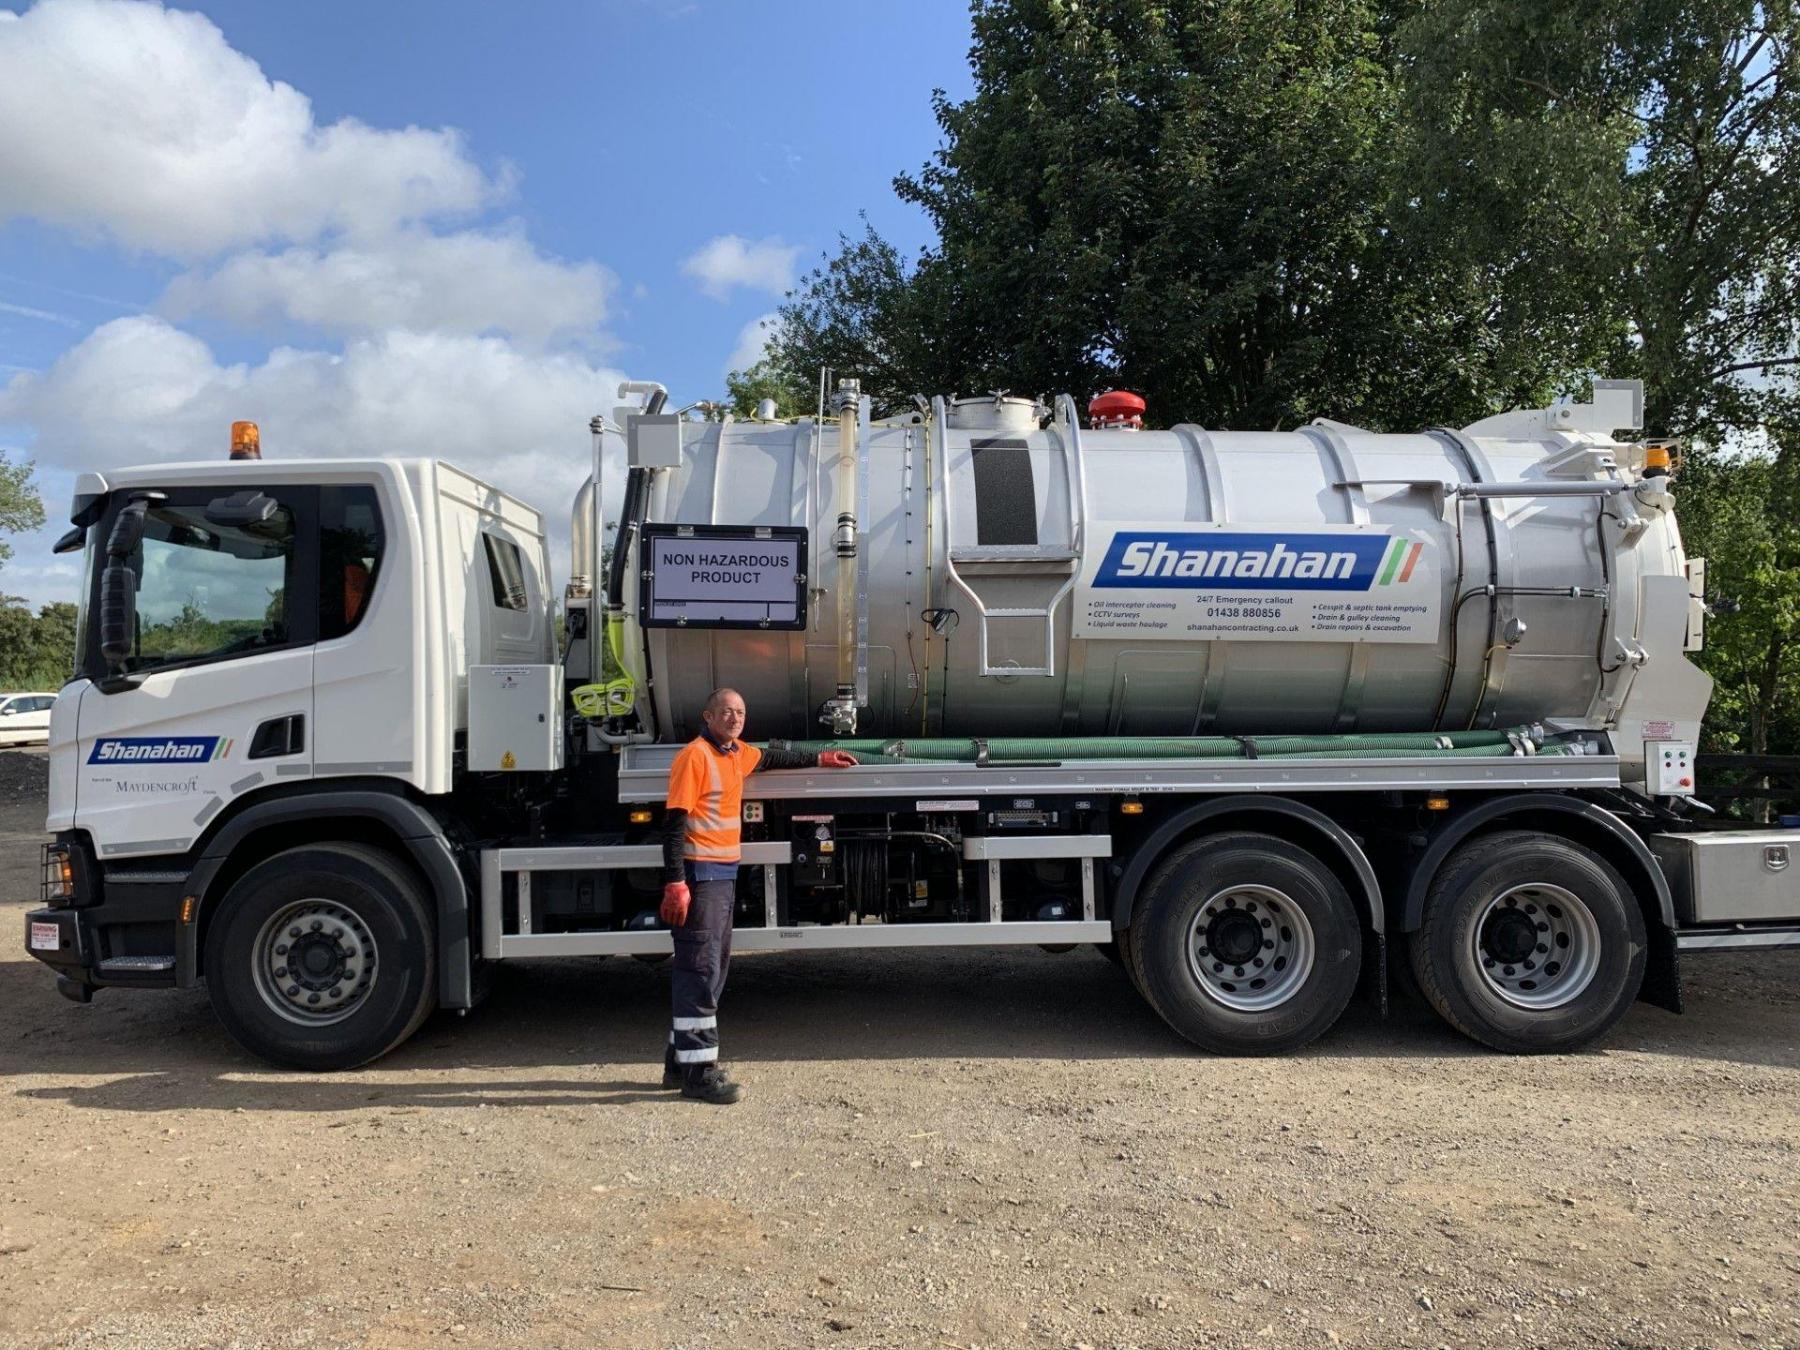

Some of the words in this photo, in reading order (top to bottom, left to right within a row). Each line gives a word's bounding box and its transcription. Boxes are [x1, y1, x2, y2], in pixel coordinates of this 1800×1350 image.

[663, 553, 695, 566] NON
[699, 554, 790, 567] HAZARDOUS
[1116, 541, 1358, 579] Shanahan
[691, 571, 761, 584] PRODUCT
[1197, 595, 1214, 603] 24/7
[1216, 596, 1263, 605] Emergency
[1265, 597, 1293, 605] callout
[1105, 601, 1145, 610] interceptor
[1147, 602, 1177, 610] cleaning
[1354, 604, 1374, 612] septic
[1393, 605, 1427, 613] emptying
[1207, 607, 1240, 617] 01438
[1242, 608, 1281, 618] 880856
[1317, 613, 1338, 621] Drain
[1347, 614, 1369, 623] gulley
[1370, 615, 1401, 623] cleaning
[1093, 621, 1115, 629] Liquid
[1139, 621, 1168, 630] haulage
[1186, 624, 1300, 633] shanahancontracting.co.uk
[1338, 624, 1363, 632] repairs
[96, 741, 206, 760] Shanahan
